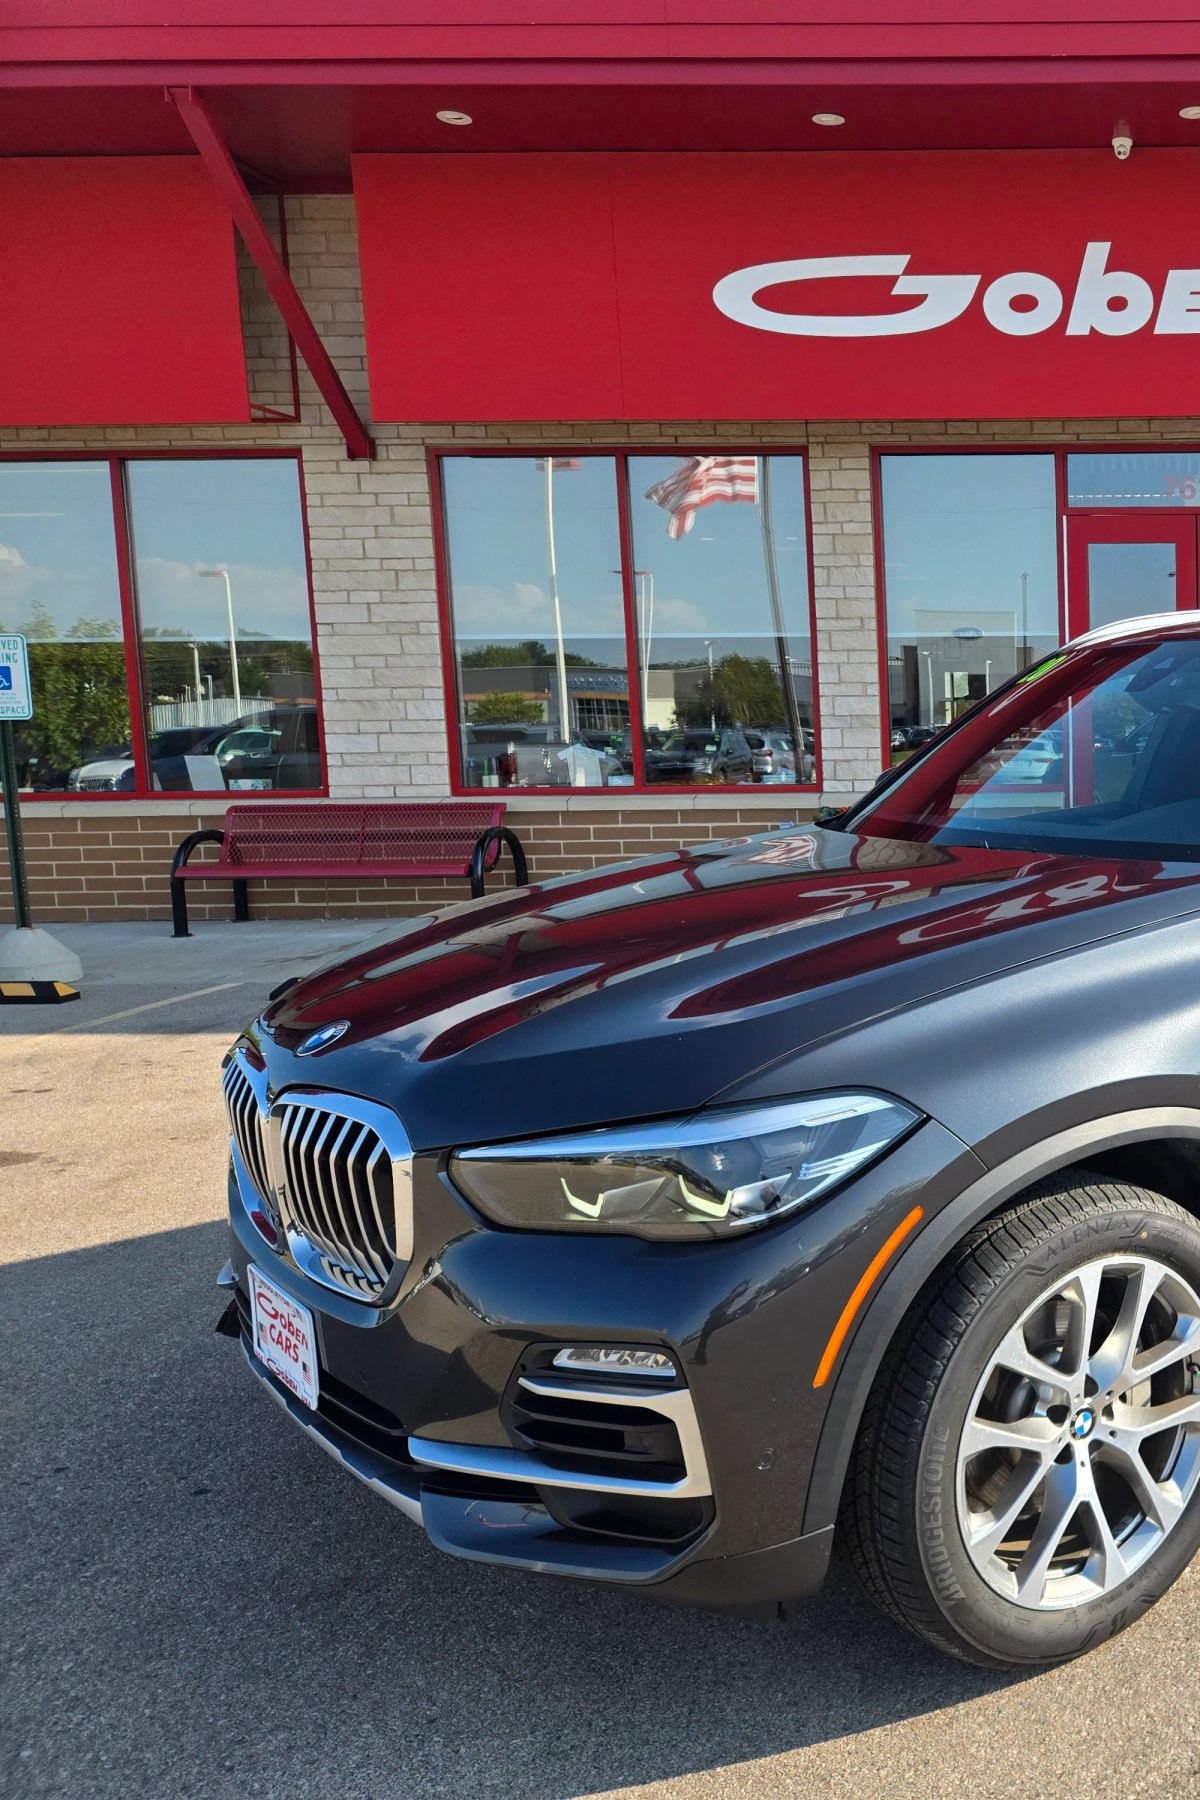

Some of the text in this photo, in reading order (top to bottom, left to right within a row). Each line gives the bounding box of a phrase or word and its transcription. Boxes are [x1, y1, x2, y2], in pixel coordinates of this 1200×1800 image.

[0, 639, 19, 650] VED
[0, 706, 27, 715] SPACE
[1045, 1214, 1130, 1262] ALENZA
[269, 1323, 299, 1364] CARS
[922, 1423, 966, 1604] BRIDGESTONE
